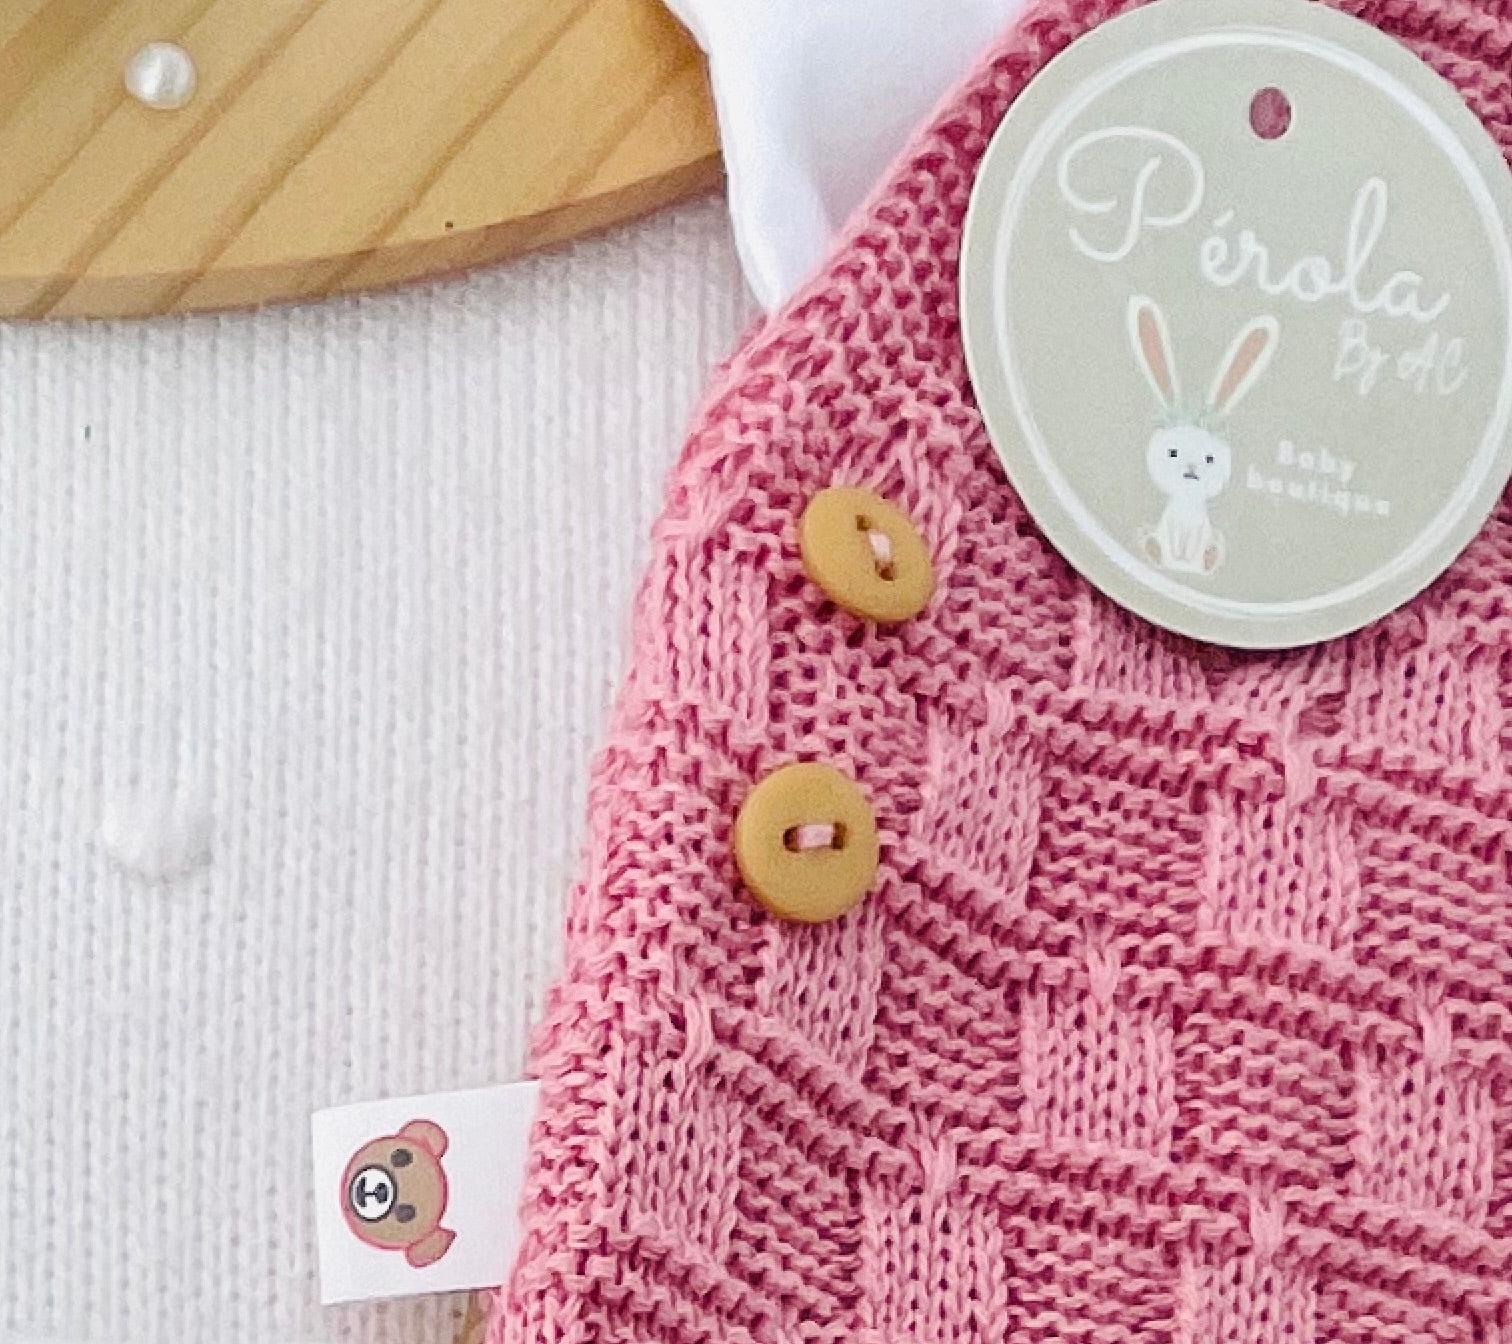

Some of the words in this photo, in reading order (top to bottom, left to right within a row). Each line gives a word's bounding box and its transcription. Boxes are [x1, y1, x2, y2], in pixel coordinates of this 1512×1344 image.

[1057, 125, 1451, 322] Pérola
[1278, 440, 1355, 485] Baby
[1246, 465, 1390, 516] boutique
